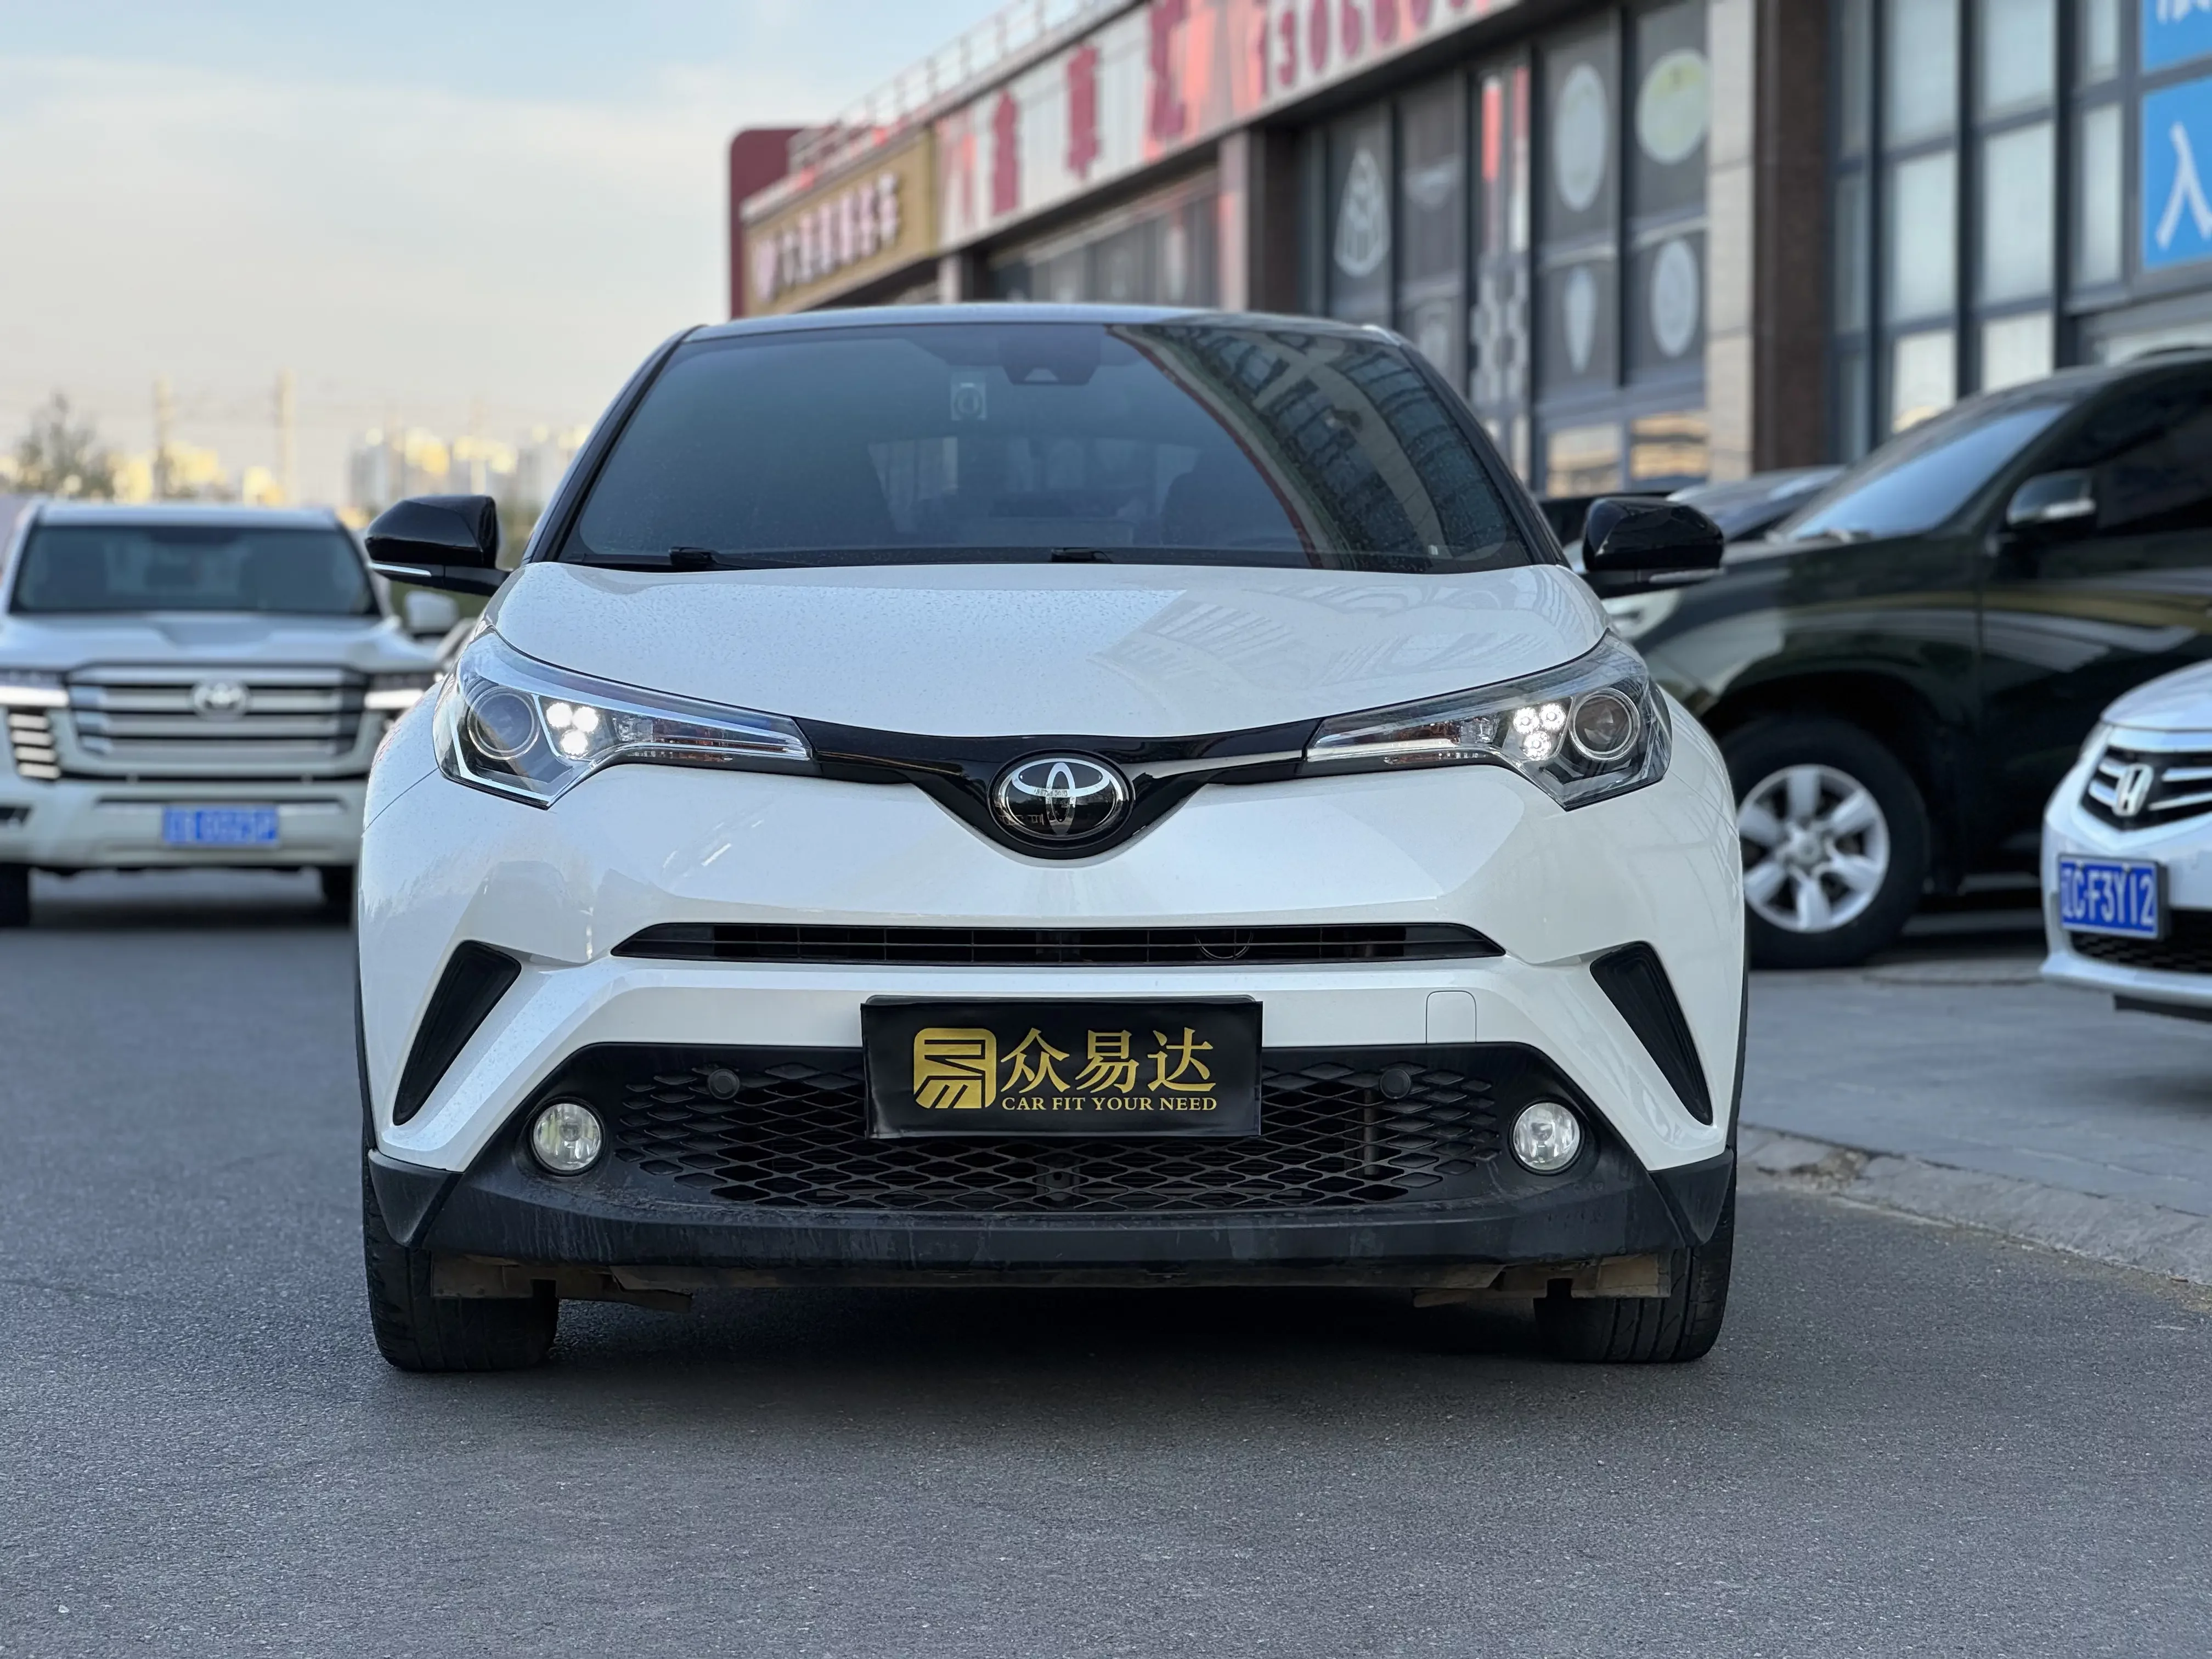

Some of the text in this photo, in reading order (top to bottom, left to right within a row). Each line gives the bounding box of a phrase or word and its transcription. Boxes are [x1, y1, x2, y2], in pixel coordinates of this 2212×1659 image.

[1000, 1026, 1216, 1094] 众易达
[1002, 1097, 1217, 1111] CAR FIT YOUR NEED
